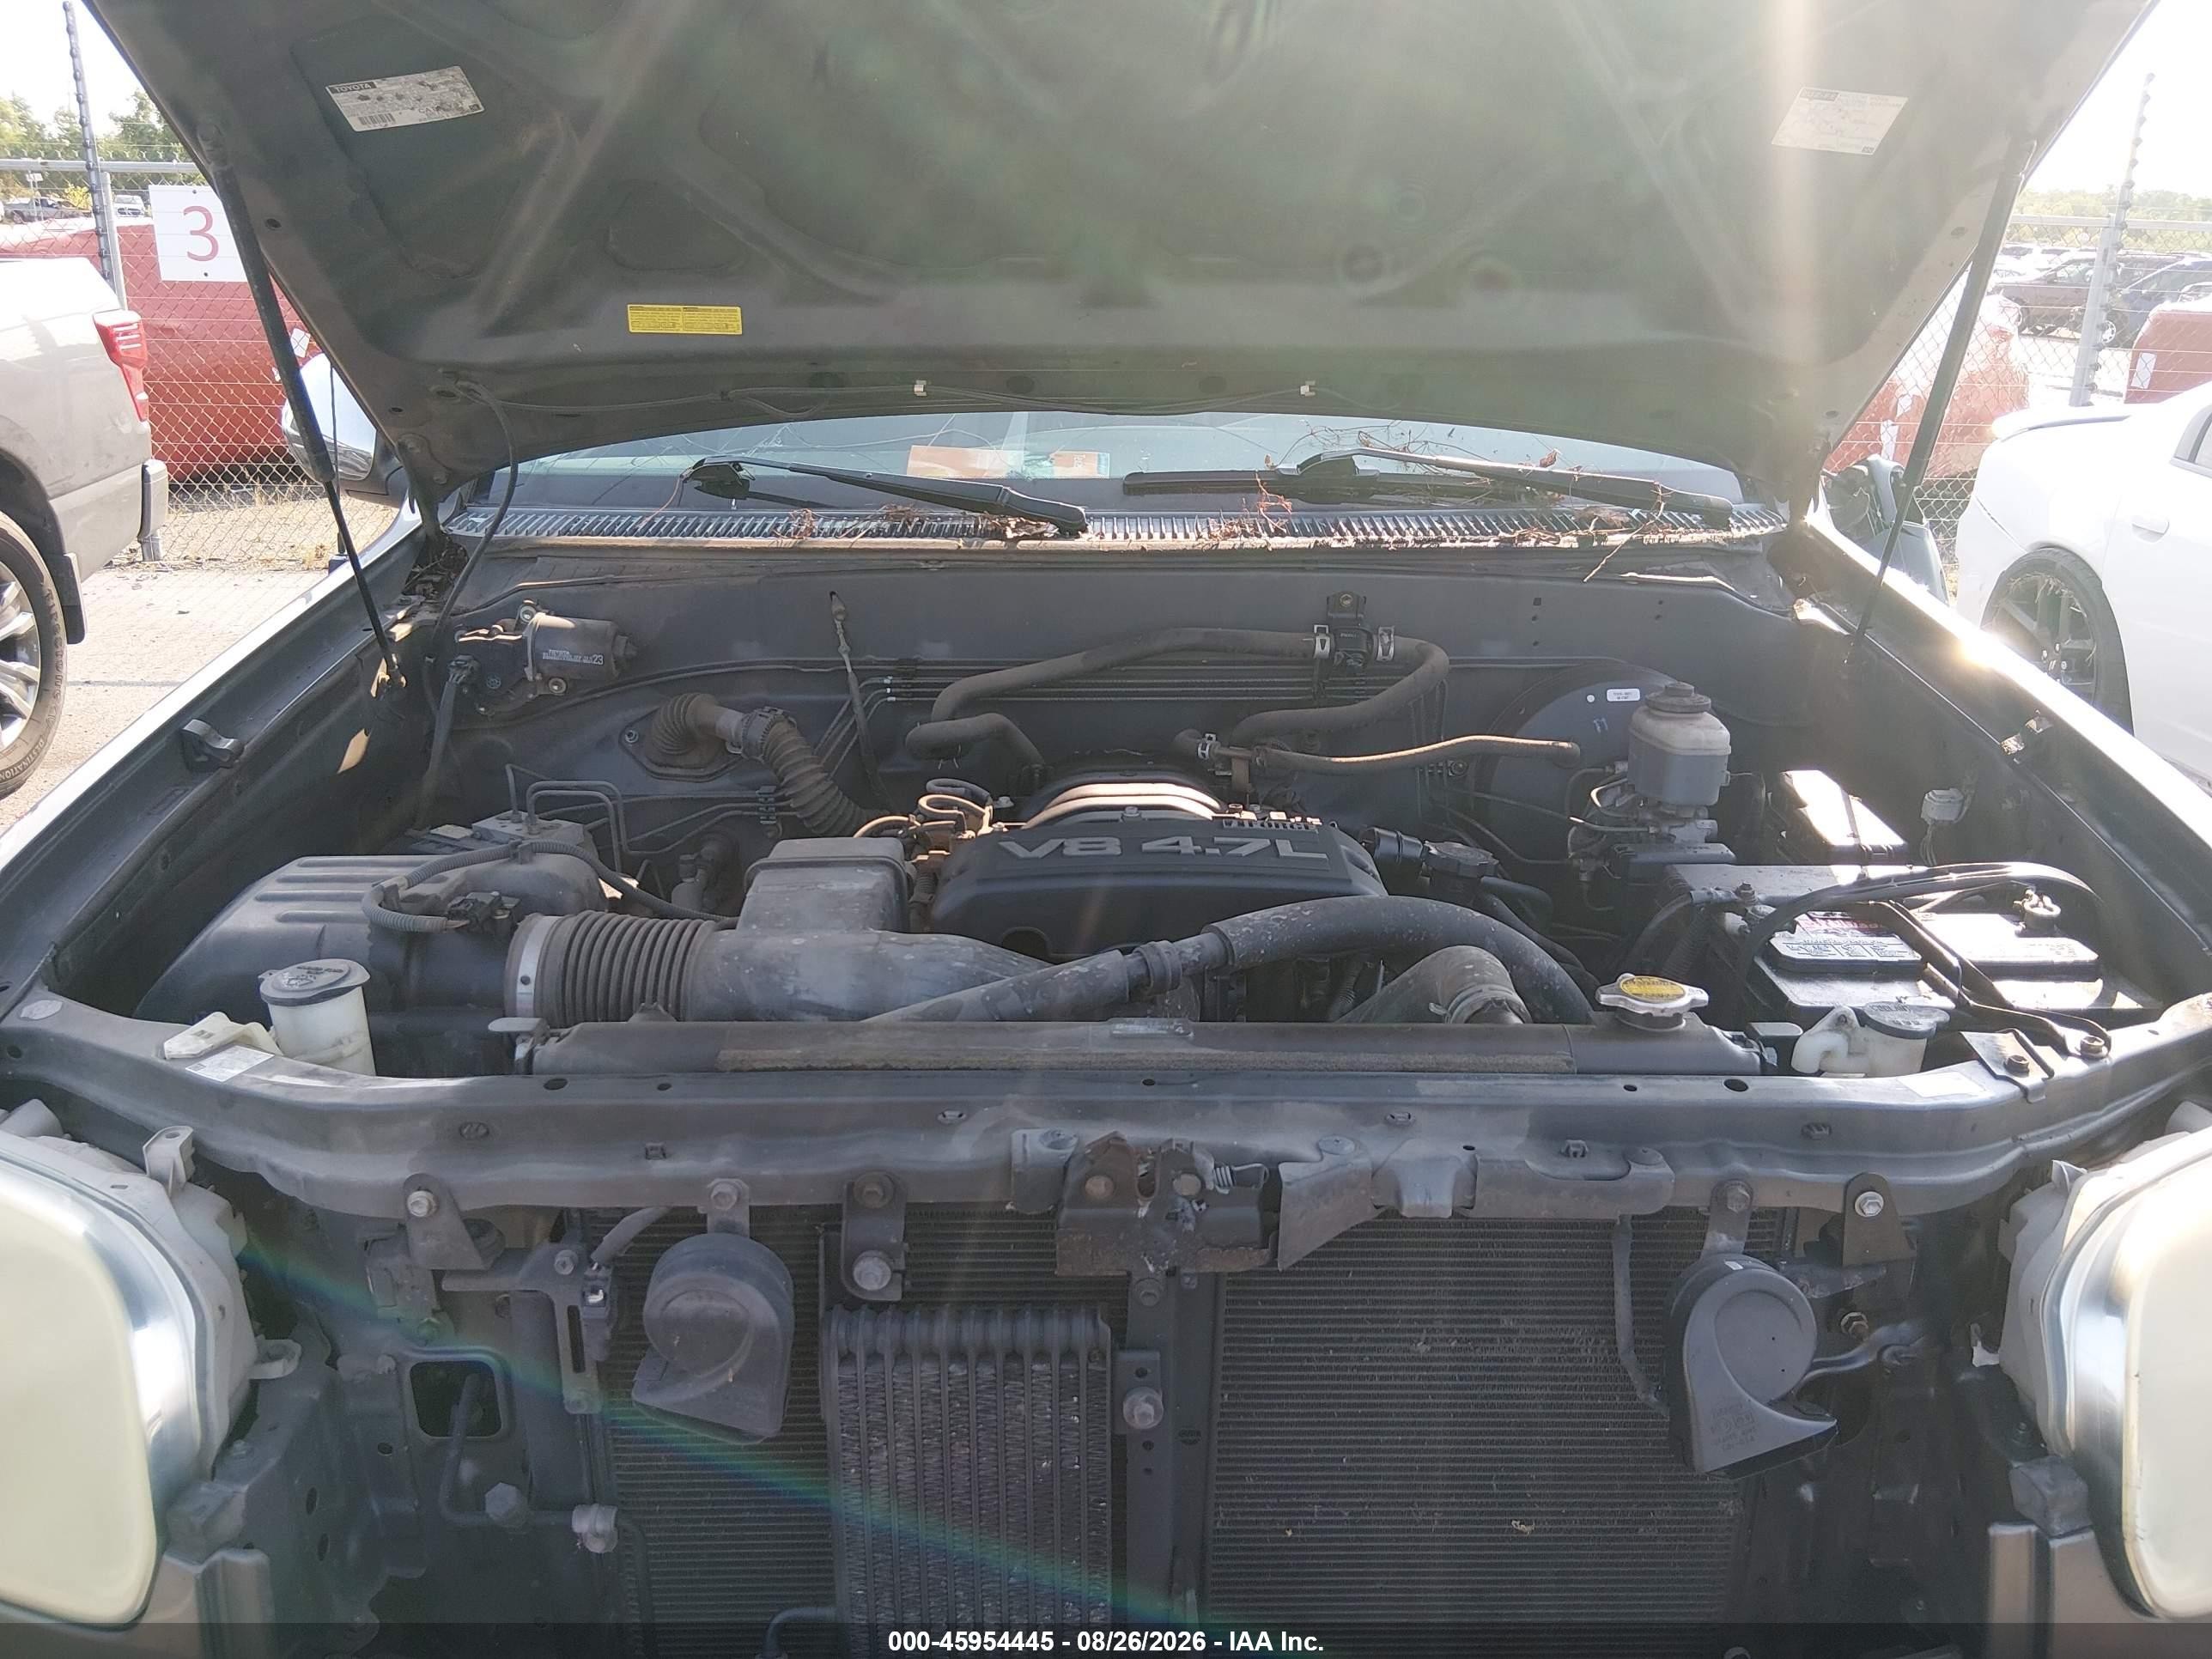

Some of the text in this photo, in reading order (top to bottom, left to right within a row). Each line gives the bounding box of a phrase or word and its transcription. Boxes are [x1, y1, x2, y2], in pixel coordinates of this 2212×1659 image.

[334, 82, 372, 93] TOYOTA
[183, 205, 219, 262] 3
[592, 654, 604, 665] 23
[998, 836, 1328, 861] V8 4.7L
